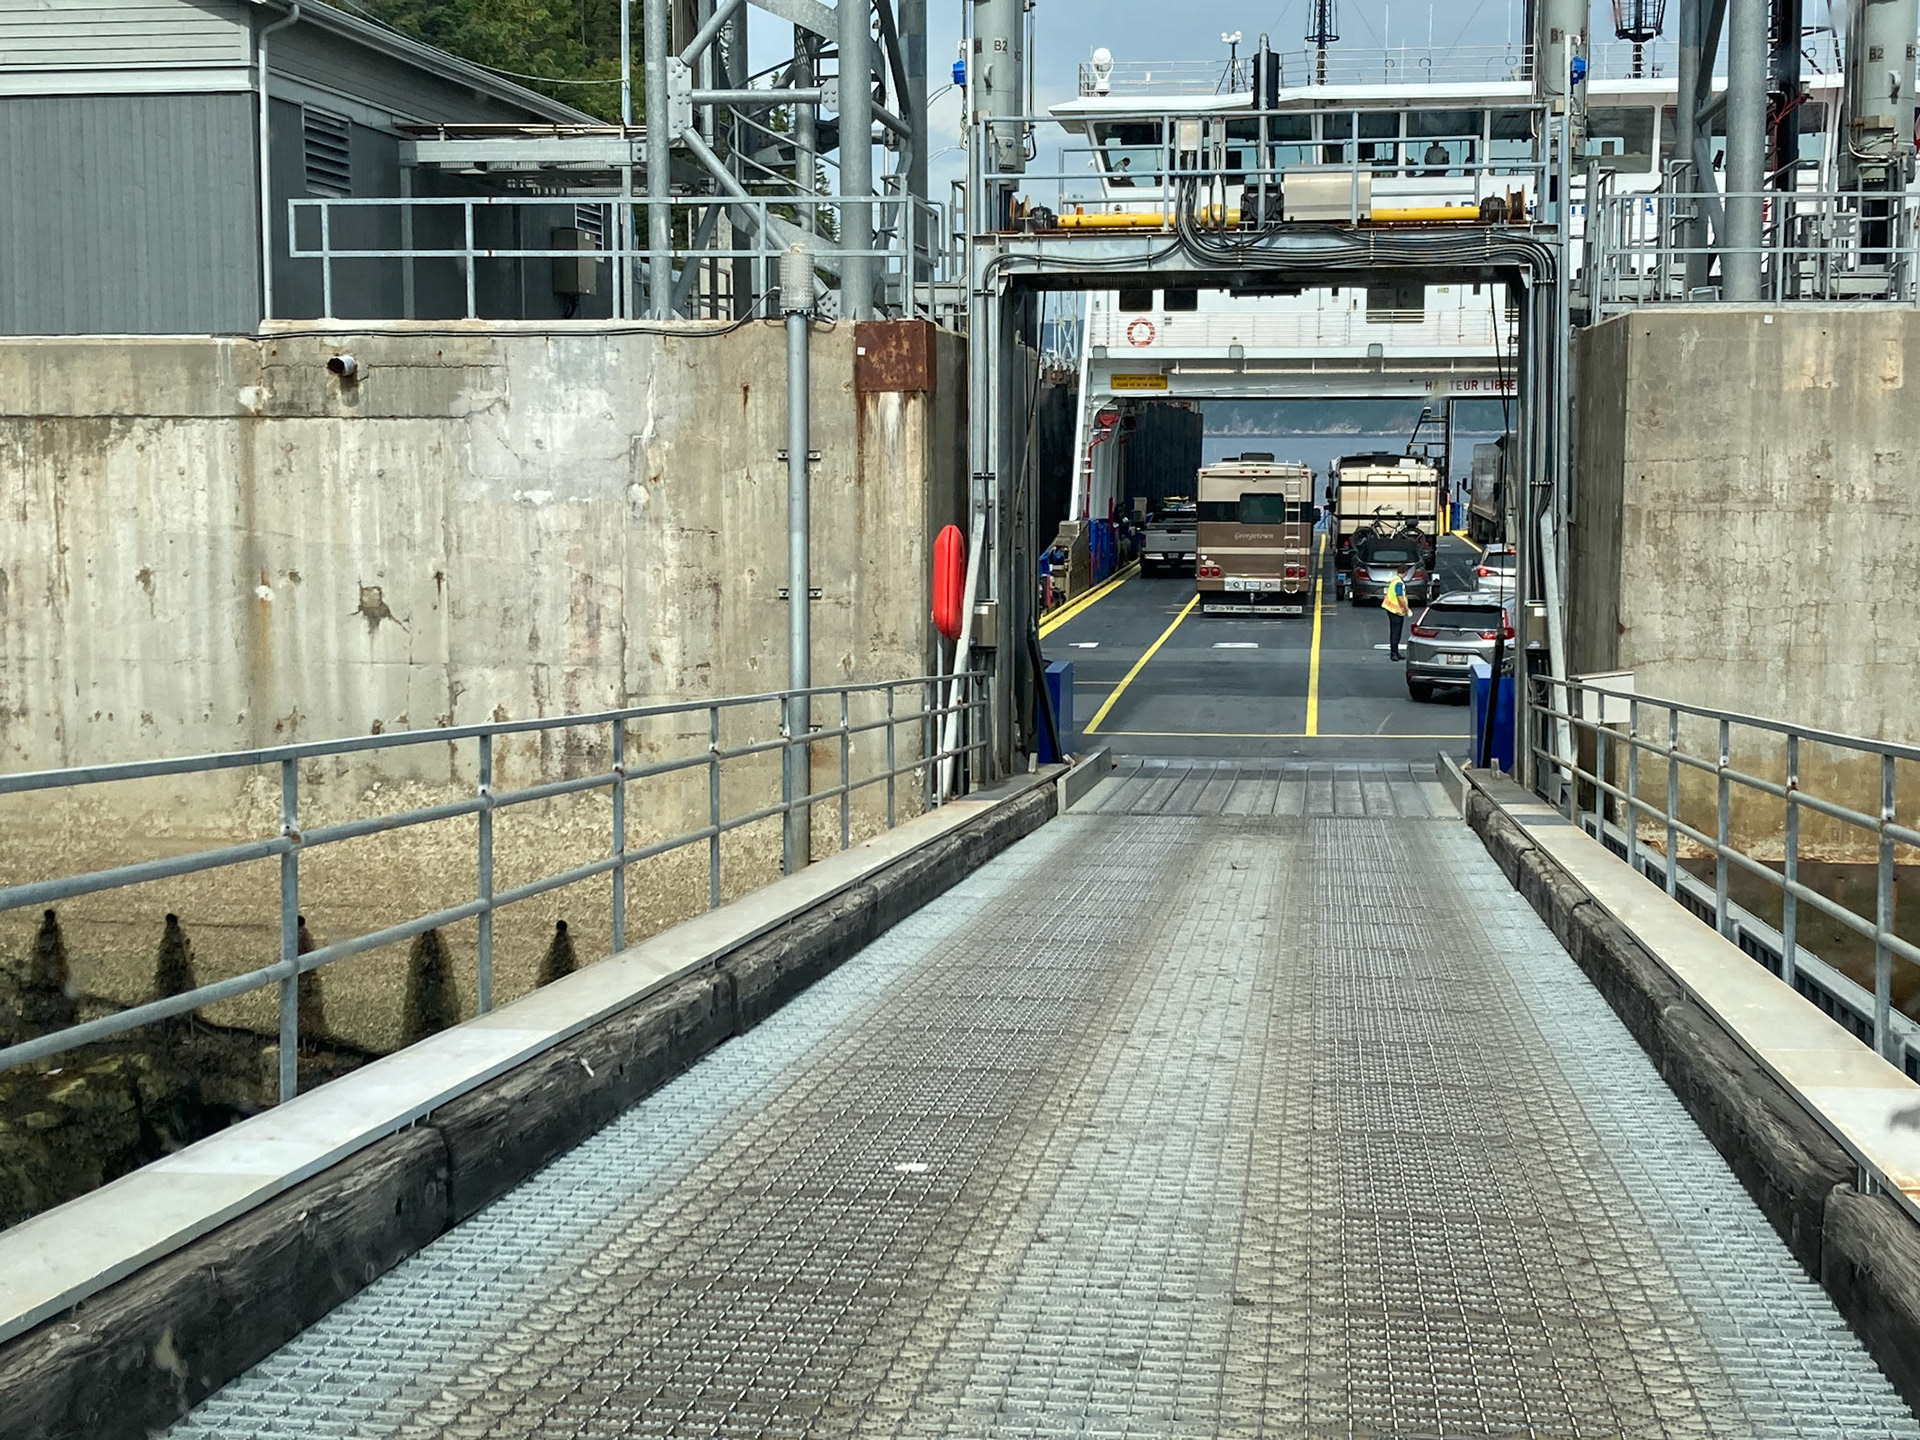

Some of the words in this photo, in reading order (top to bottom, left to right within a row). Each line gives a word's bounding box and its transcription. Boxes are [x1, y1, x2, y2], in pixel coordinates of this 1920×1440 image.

[1551, 29, 1564, 41] B1
[994, 40, 1008, 51] B2
[1870, 48, 1884, 60] B2
[1425, 379, 1478, 391] HATEUR
[1483, 379, 1517, 391] LIBRE
[1234, 531, 1274, 541] Georgetown
